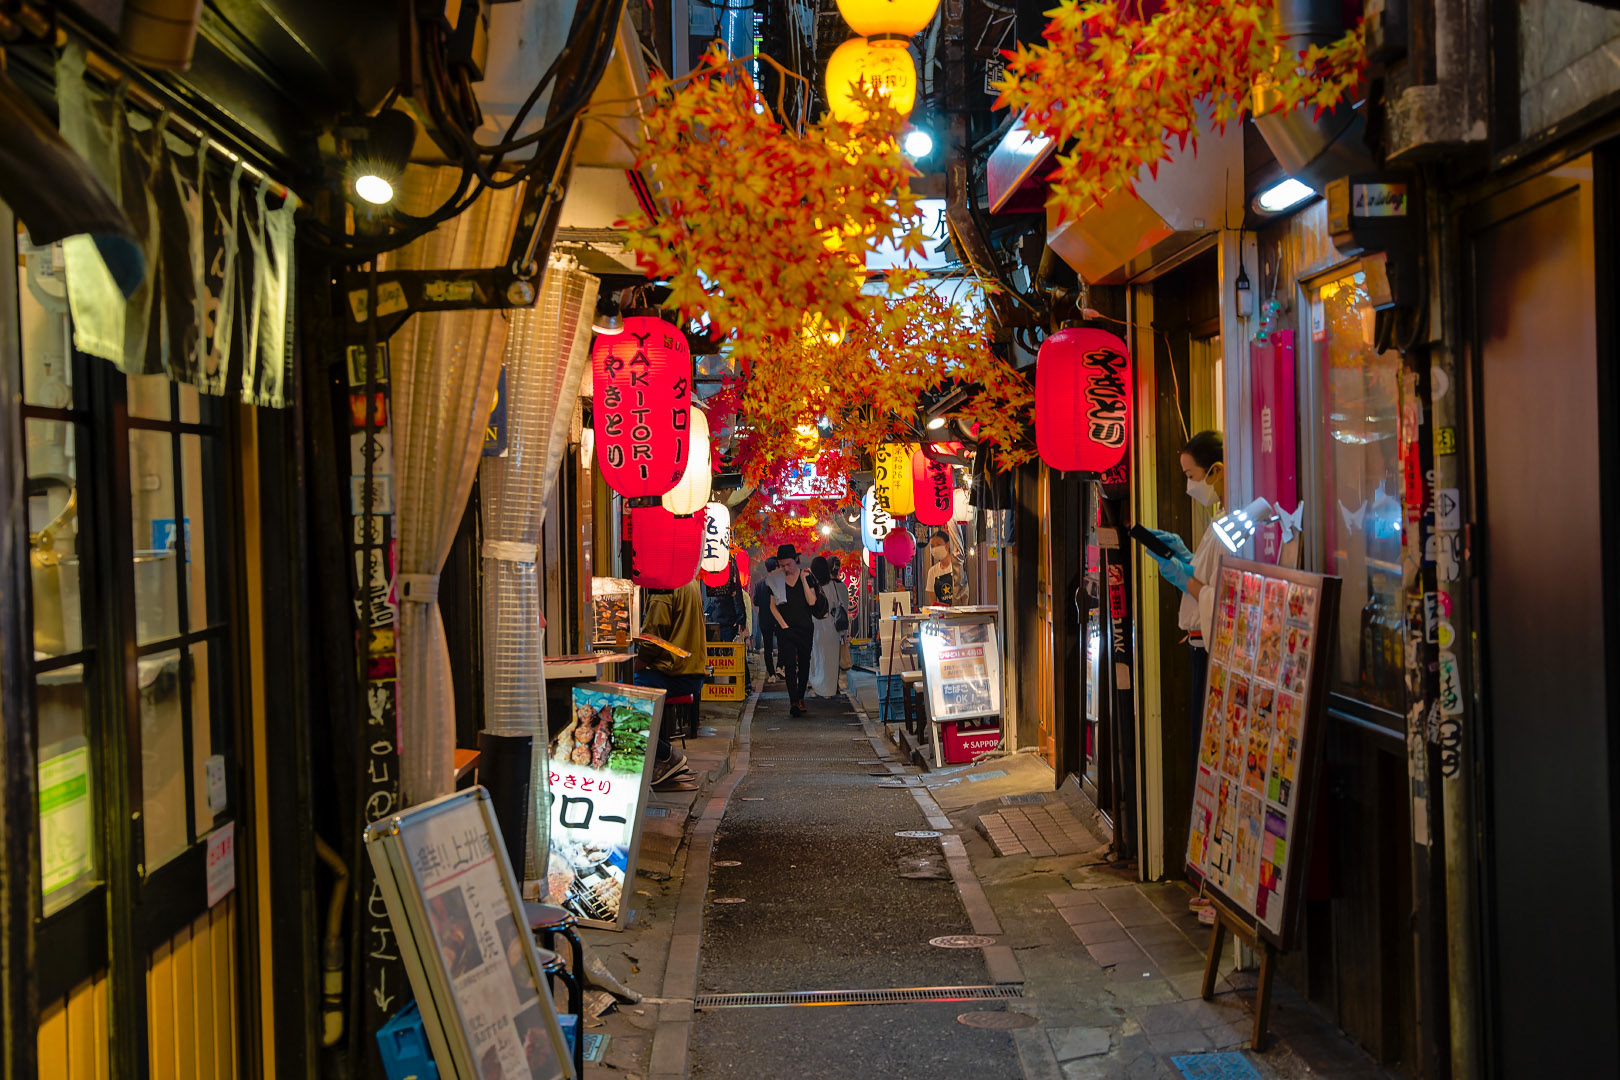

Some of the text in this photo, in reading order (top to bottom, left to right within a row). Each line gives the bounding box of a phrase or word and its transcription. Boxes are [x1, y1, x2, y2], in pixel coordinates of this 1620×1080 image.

[604, 355, 624, 469] やきとり
[629, 331, 653, 480] YAKITORI
[672, 375, 688, 464] タロー
[708, 658, 735, 667] KIRIN
[708, 686, 735, 695] KIRIN
[944, 684, 968, 694] たばこ
[549, 771, 612, 795] やきとり
[550, 791, 627, 830] ロー
